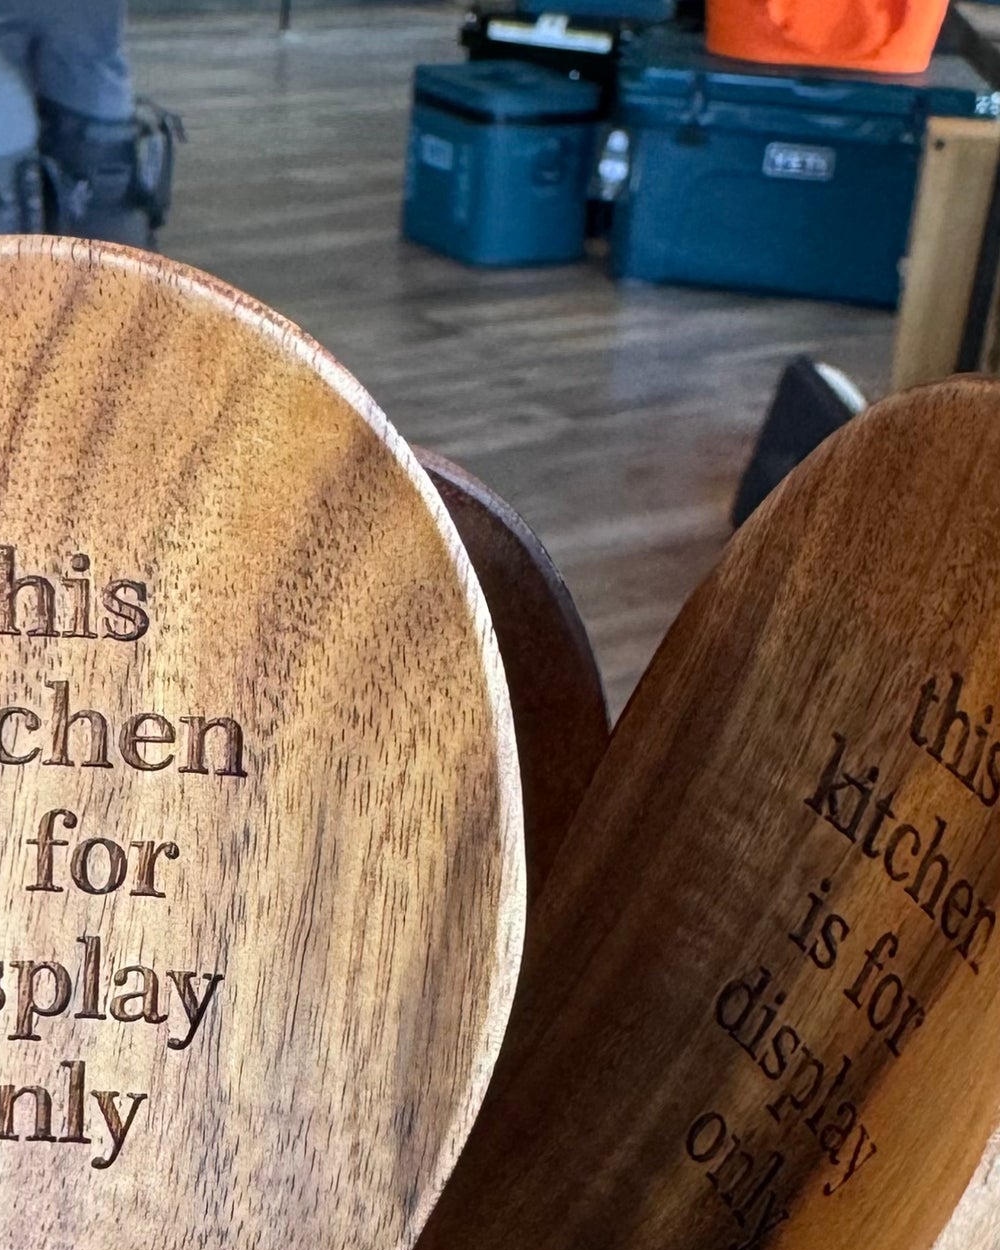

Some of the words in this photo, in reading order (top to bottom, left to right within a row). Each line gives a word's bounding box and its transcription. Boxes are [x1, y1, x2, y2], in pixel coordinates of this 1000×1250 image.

[25, 808, 180, 898] for
[803, 731, 996, 976] kitchen
[788, 877, 850, 970] is
[843, 931, 926, 1058] for
[715, 965, 878, 1197] display
